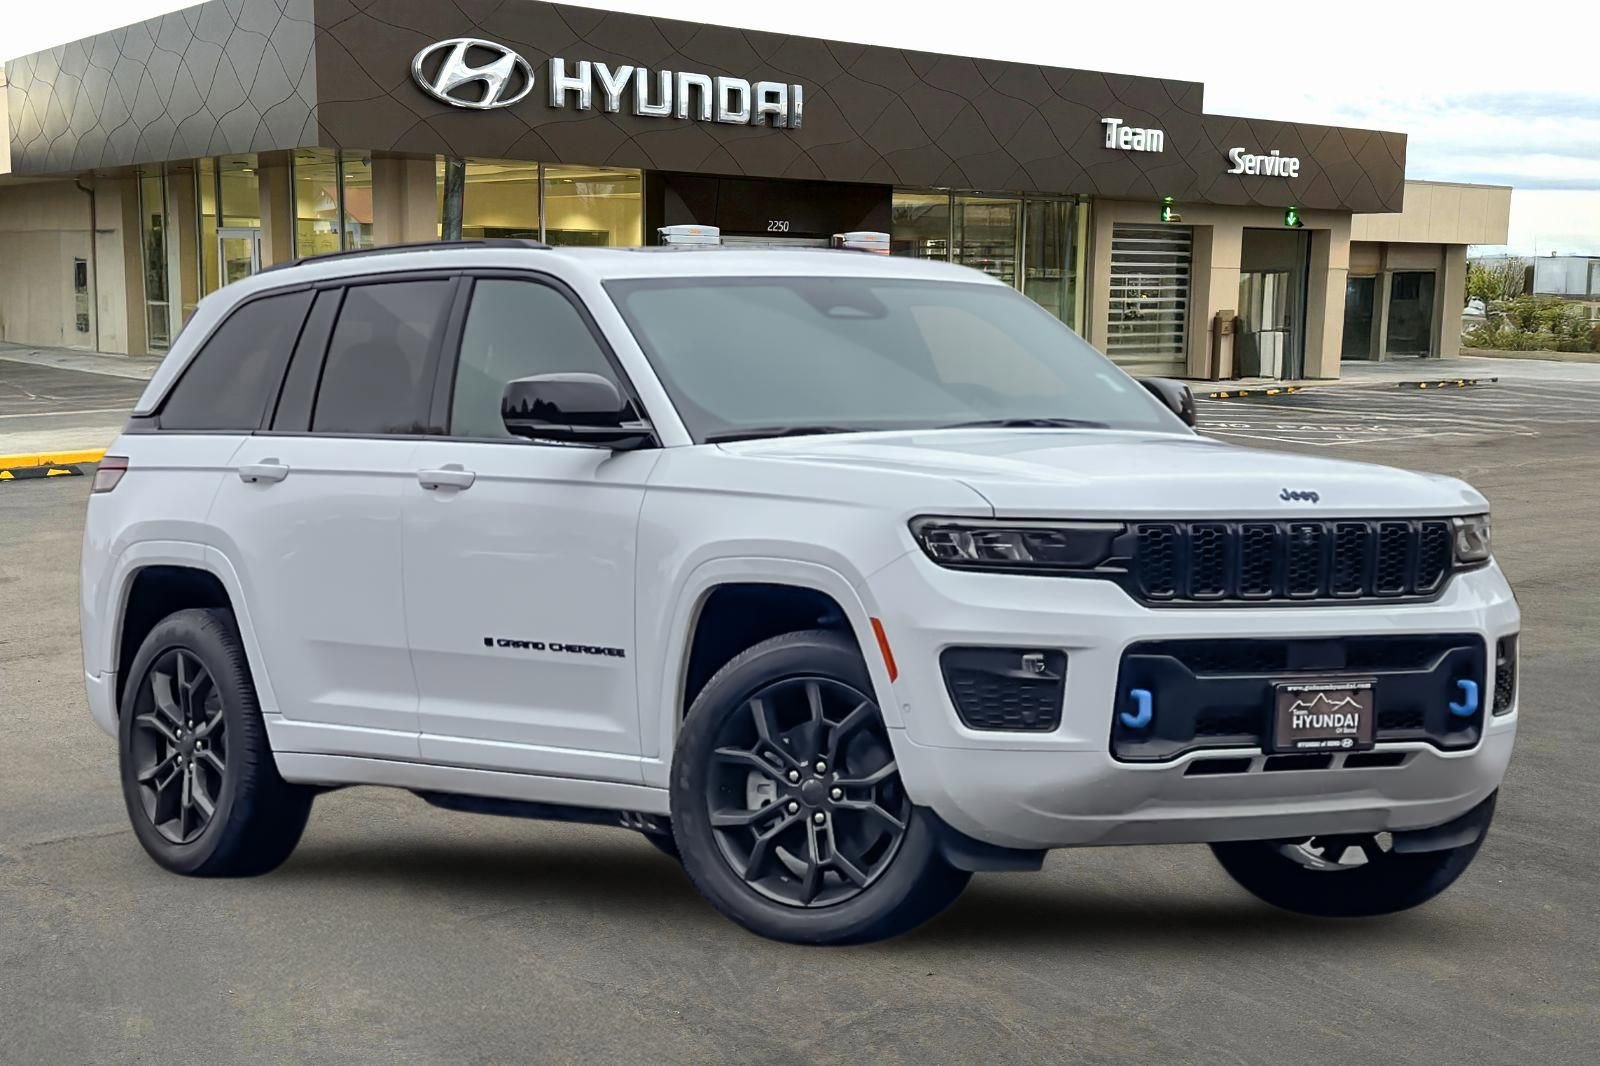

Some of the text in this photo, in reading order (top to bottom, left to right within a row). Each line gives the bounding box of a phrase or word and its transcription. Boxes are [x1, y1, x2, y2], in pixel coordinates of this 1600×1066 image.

[548, 57, 803, 129] HYUNDAI
[1101, 117, 1164, 152] Team
[1227, 147, 1300, 178] Service
[767, 220, 790, 232] 2250
[1280, 488, 1320, 503] Jeep
[497, 638, 626, 658] GRAND CHEROKEE
[1293, 713, 1359, 729] HYUNDAI
